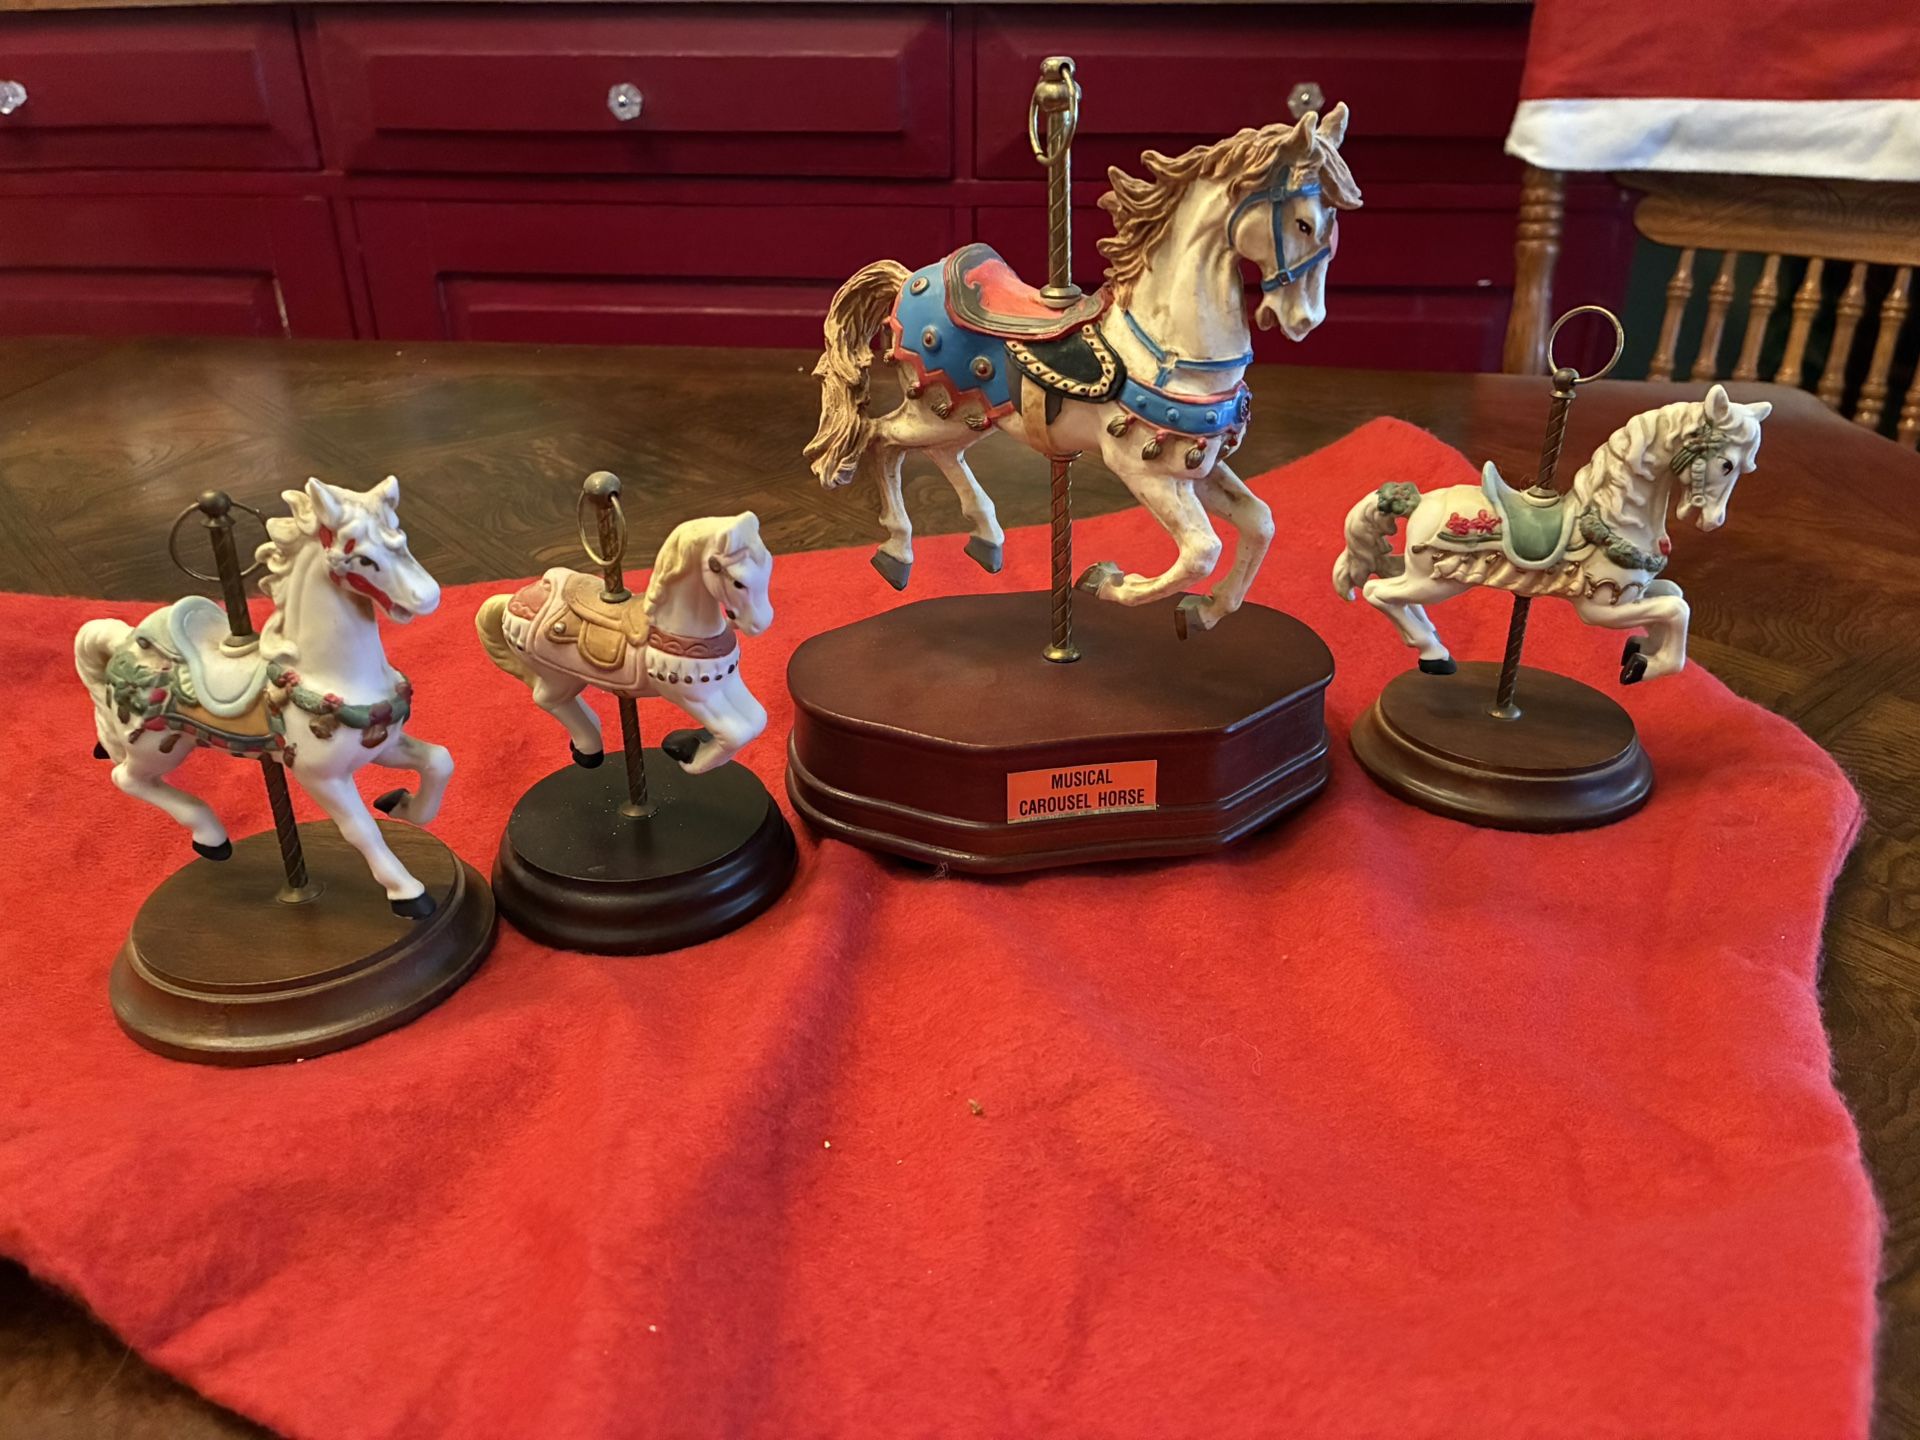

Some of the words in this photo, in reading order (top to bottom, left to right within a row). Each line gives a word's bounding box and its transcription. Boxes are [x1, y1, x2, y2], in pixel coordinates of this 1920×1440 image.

[1051, 768, 1113, 790] MUSICAL
[1019, 794, 1092, 816] CAROUSEL
[1097, 788, 1145, 808] HORSE
